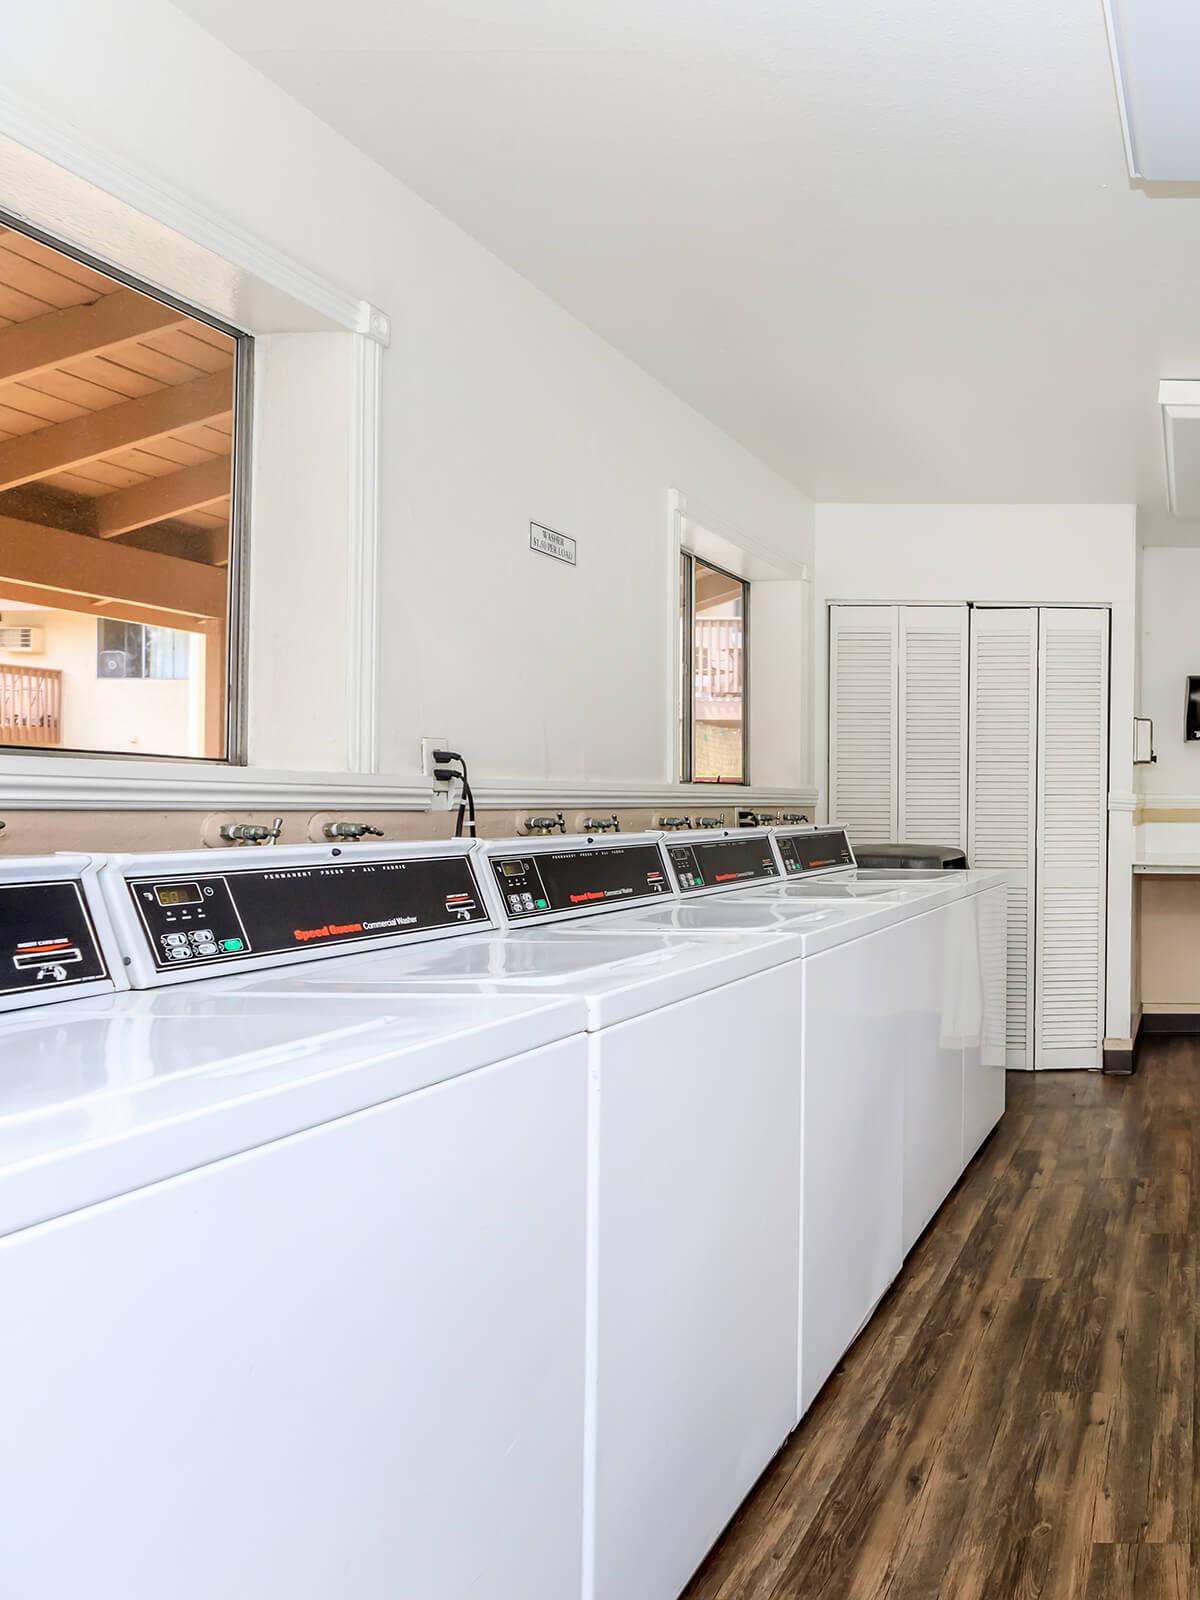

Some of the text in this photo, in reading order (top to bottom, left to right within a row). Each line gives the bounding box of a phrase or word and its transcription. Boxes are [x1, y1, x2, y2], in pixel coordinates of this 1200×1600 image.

[542, 530, 564, 547] WASHER
[293, 926, 329, 941] Speed
[363, 918, 396, 930] Commercial
[396, 916, 417, 925] Washer
